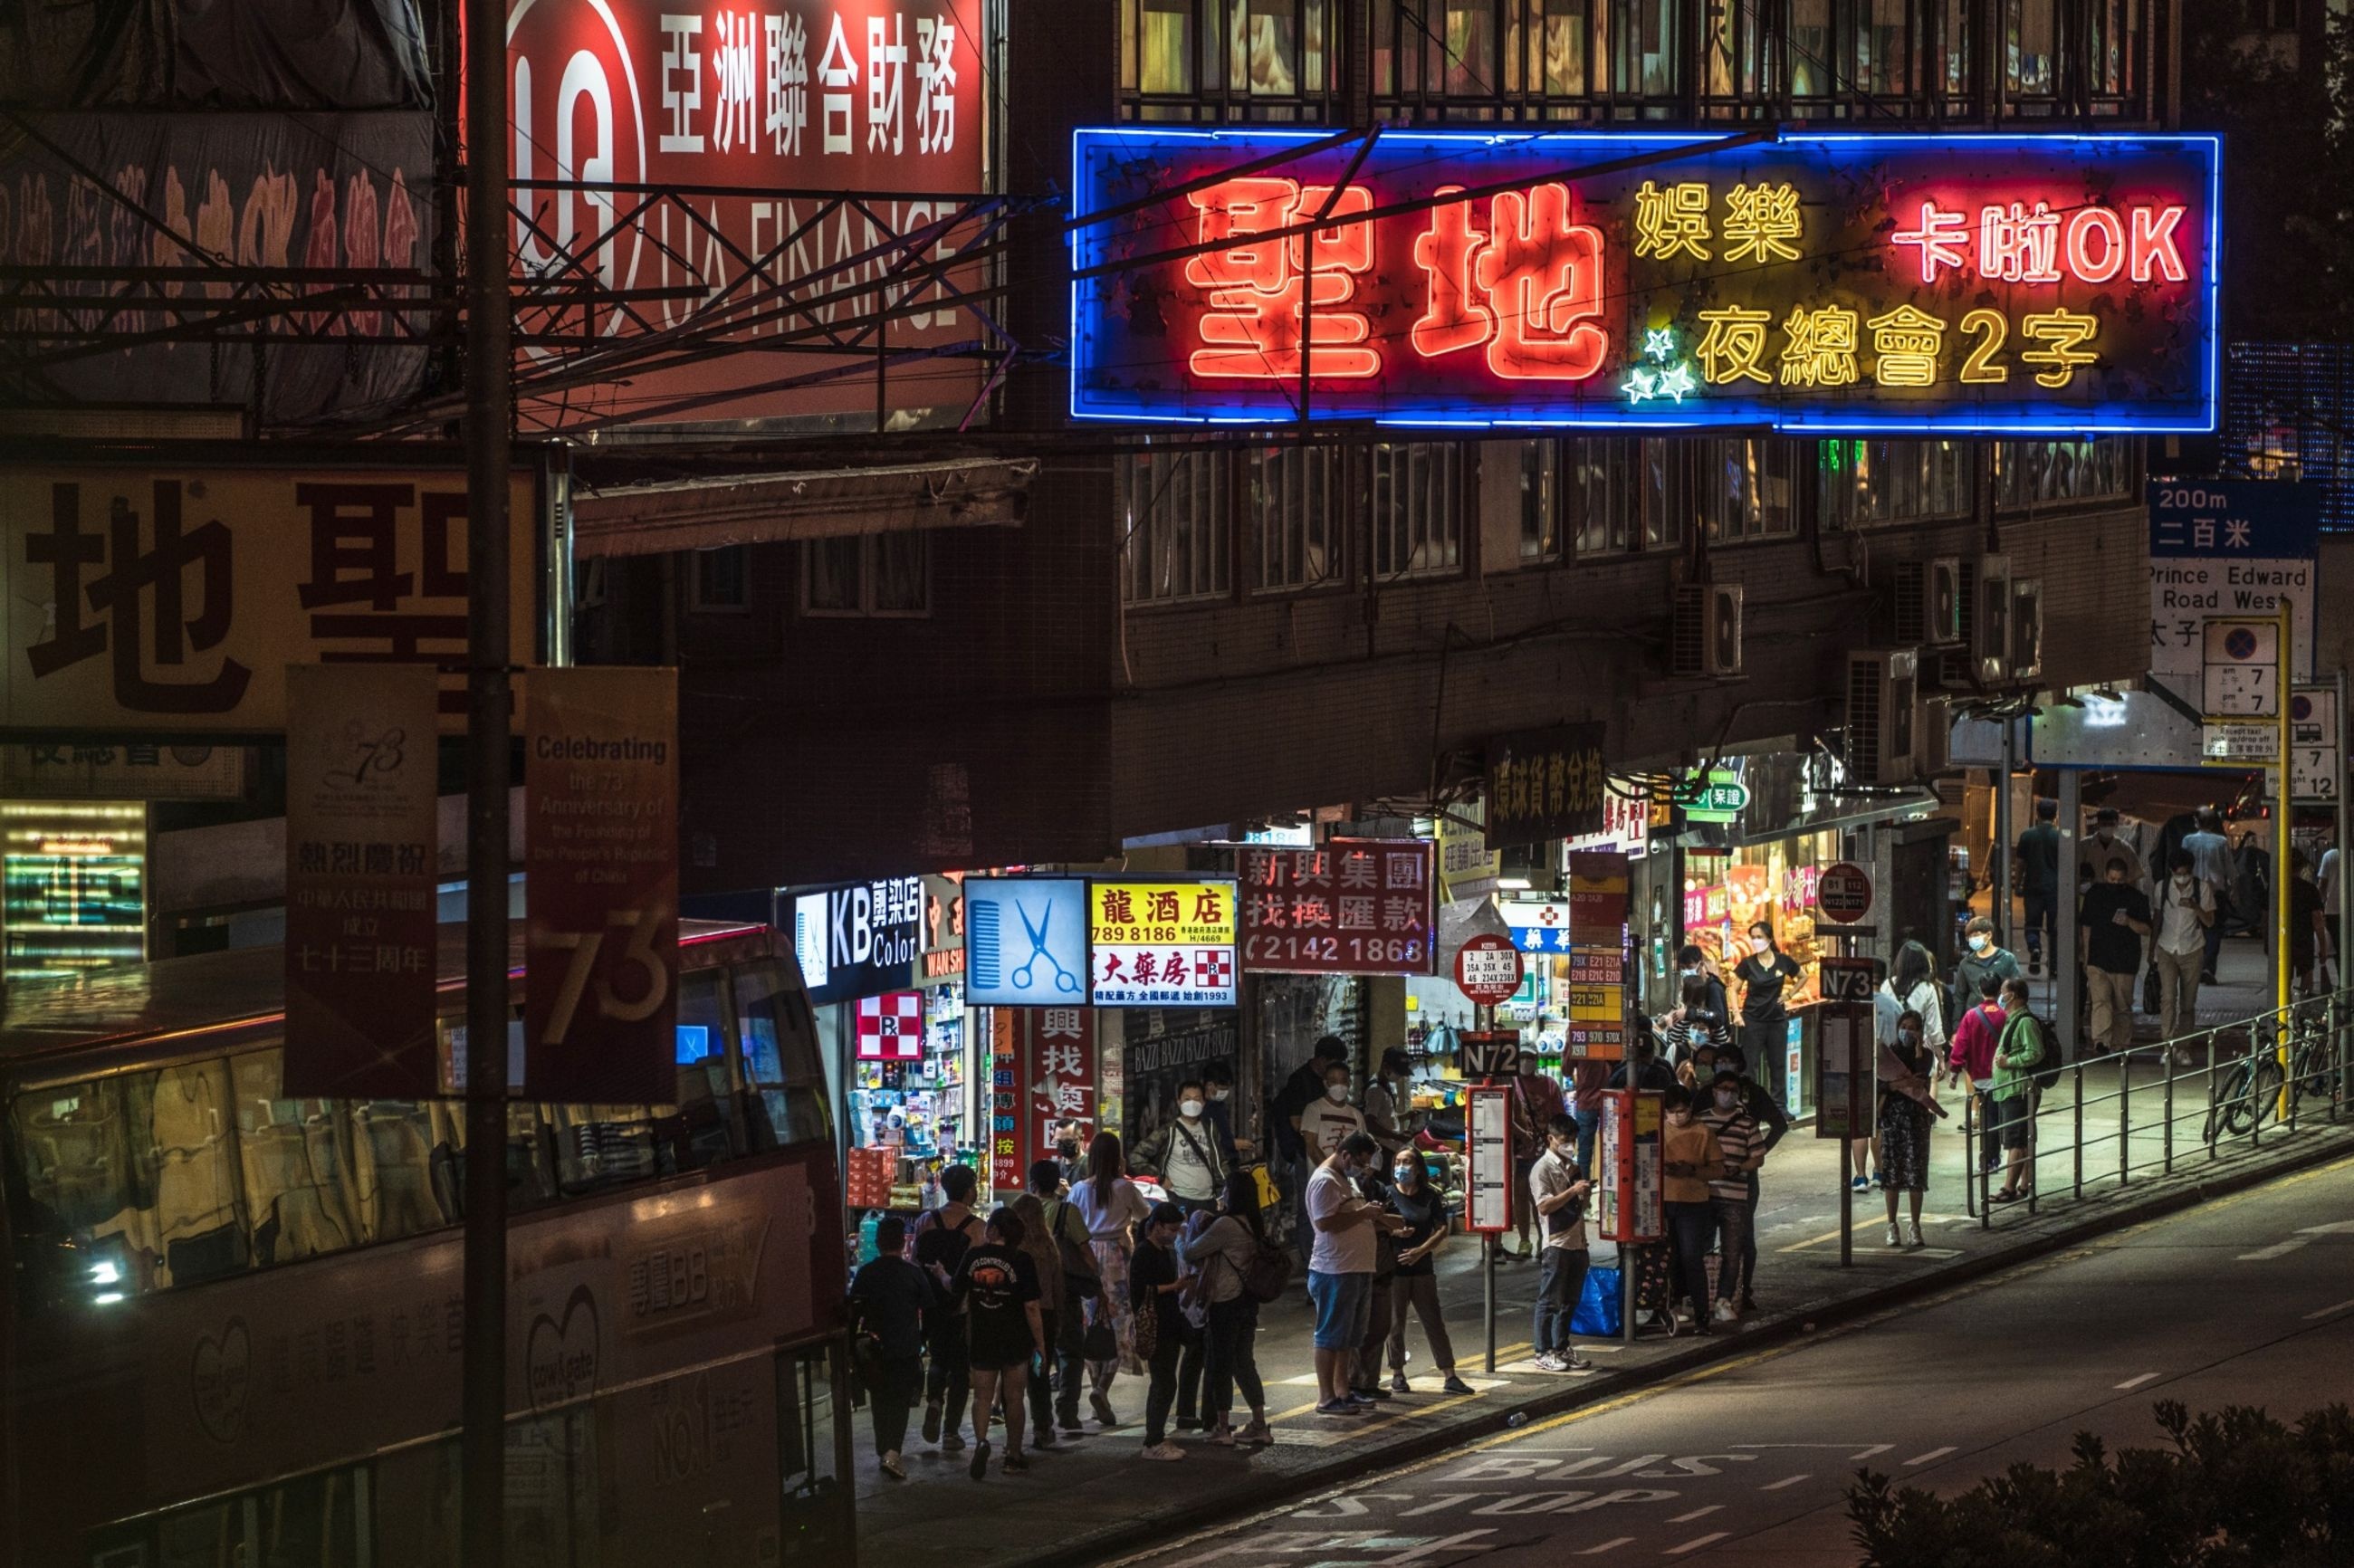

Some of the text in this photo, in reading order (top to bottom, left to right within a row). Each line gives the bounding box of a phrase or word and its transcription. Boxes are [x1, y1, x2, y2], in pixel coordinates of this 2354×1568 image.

[658, 11, 958, 157] 亞洲聯合財務
[1634, 180, 1804, 263] 娛樂
[1891, 200, 2189, 283] 卡啦OK
[751, 198, 957, 336] FINANCE
[1184, 176, 1610, 380] 聖地
[1696, 304, 2100, 388] 夜總會2字
[2159, 490, 2227, 509] 200m
[2158, 519, 2252, 548] 二百米
[2228, 567, 2307, 586] Edward
[2163, 590, 2218, 609] Road
[2251, 669, 2263, 685] 7
[2251, 695, 2263, 712] 7
[536, 735, 666, 766] Celebrating
[2311, 751, 2321, 767] 7
[2311, 778, 2331, 794] 12
[539, 797, 640, 819] Anniversary
[298, 841, 426, 875] 熱烈慶祝
[1248, 849, 1424, 890] 新興集團
[1828, 880, 1839, 890] 81
[872, 876, 919, 928] 剪染店
[1101, 888, 1222, 924] 龍酒店
[1246, 893, 1423, 932] 找換匯款
[832, 885, 872, 968] KB
[1130, 926, 1176, 942] 8186
[873, 930, 916, 968] Color
[1264, 935, 1338, 961] 2142
[1469, 952, 1474, 961] 2
[1486, 952, 1494, 961] 2A
[1590, 956, 1603, 967] E21
[1605, 956, 1622, 967] E21A
[534, 907, 672, 1047] 73
[927, 951, 949, 978] WAN
[1467, 963, 1479, 971] 35A
[1484, 963, 1496, 971] 35X
[1571, 970, 1586, 980] E21B
[1589, 970, 1603, 980] E21C
[1822, 970, 1871, 997] N73
[1572, 1031, 1621, 1043] 793 970 970X
[1463, 1043, 1517, 1073] N72
[1432, 1454, 1760, 1482] BUS
[1290, 1488, 1682, 1519] STOP
